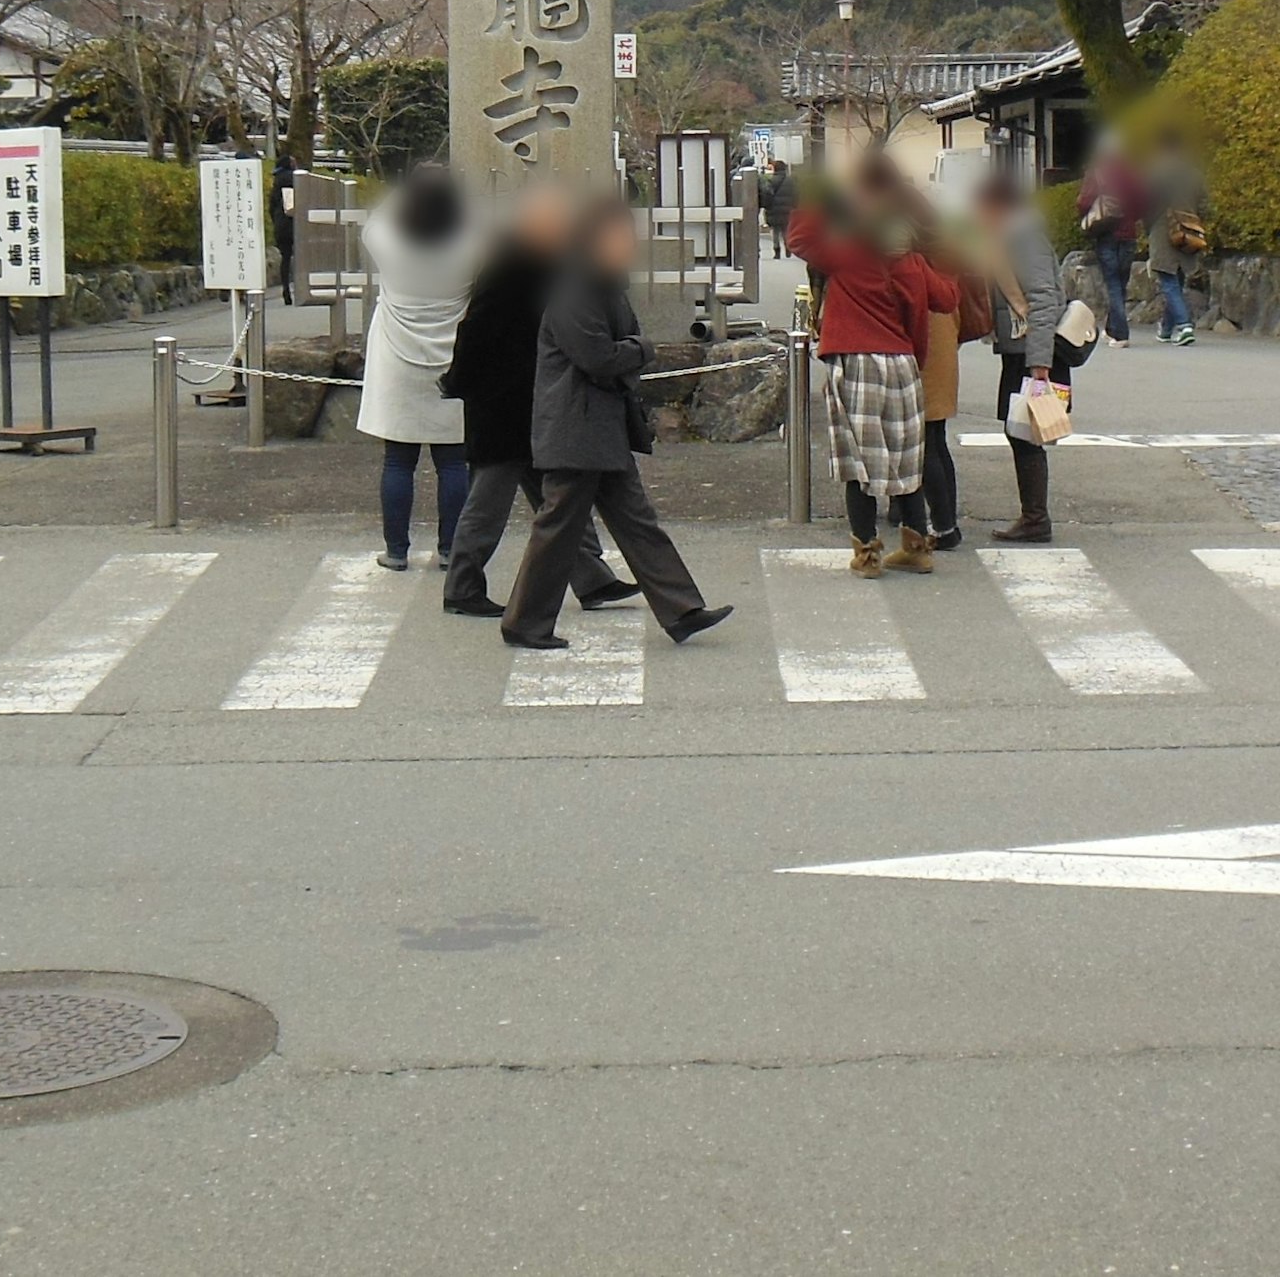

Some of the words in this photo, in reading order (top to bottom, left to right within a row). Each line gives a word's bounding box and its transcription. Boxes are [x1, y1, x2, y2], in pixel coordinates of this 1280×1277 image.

[617, 38, 633, 74] 止まれ
[5, 176, 23, 267] 駐車場
[25, 163, 41, 286] 天龍寺参拝用
